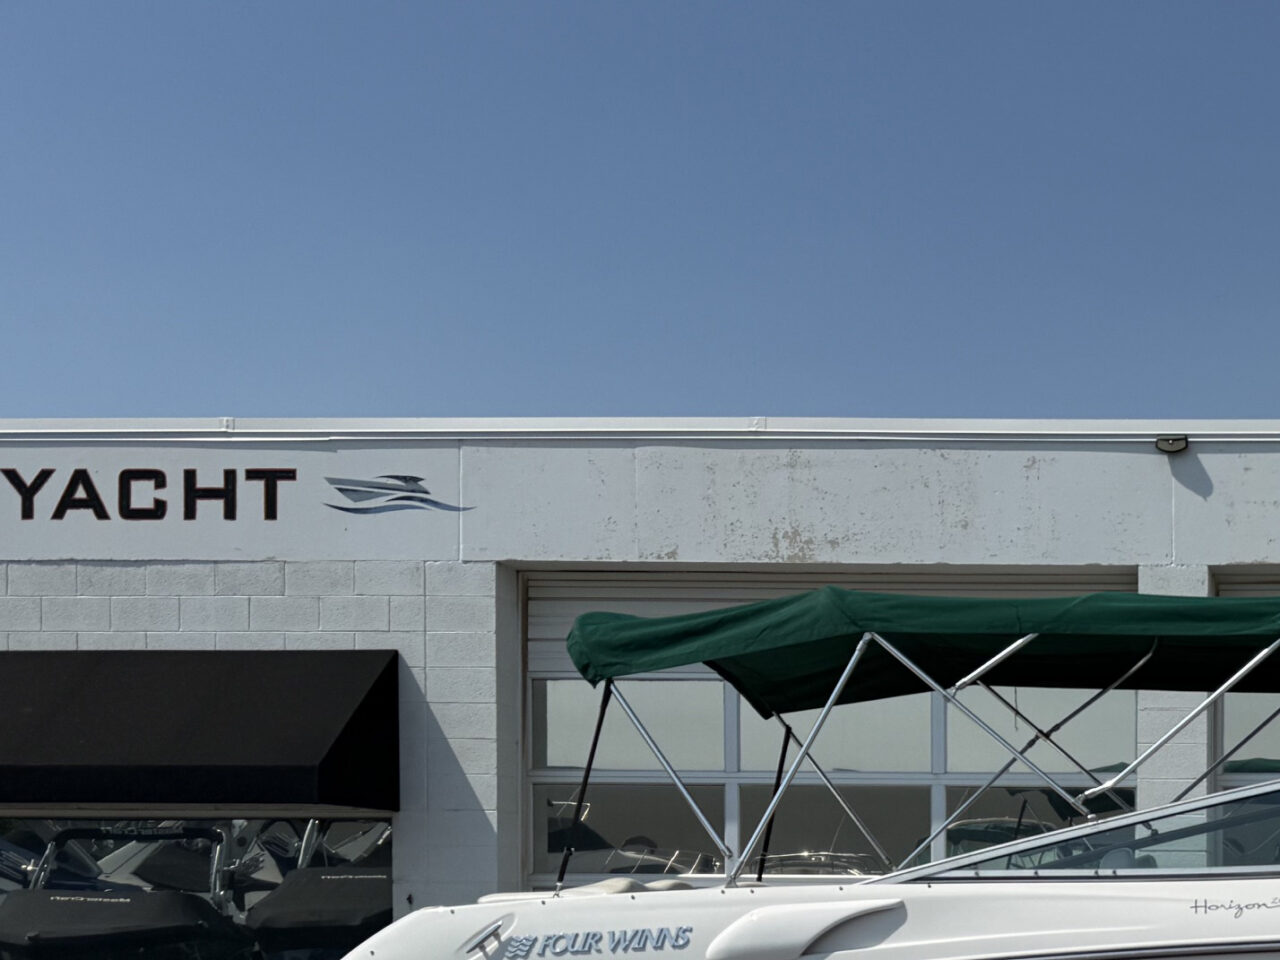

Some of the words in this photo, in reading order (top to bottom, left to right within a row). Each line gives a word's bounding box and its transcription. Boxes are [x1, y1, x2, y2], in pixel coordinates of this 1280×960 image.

[0, 468, 297, 521] YACHT
[537, 932, 604, 958] FOUR
[607, 926, 693, 954] WINNS
